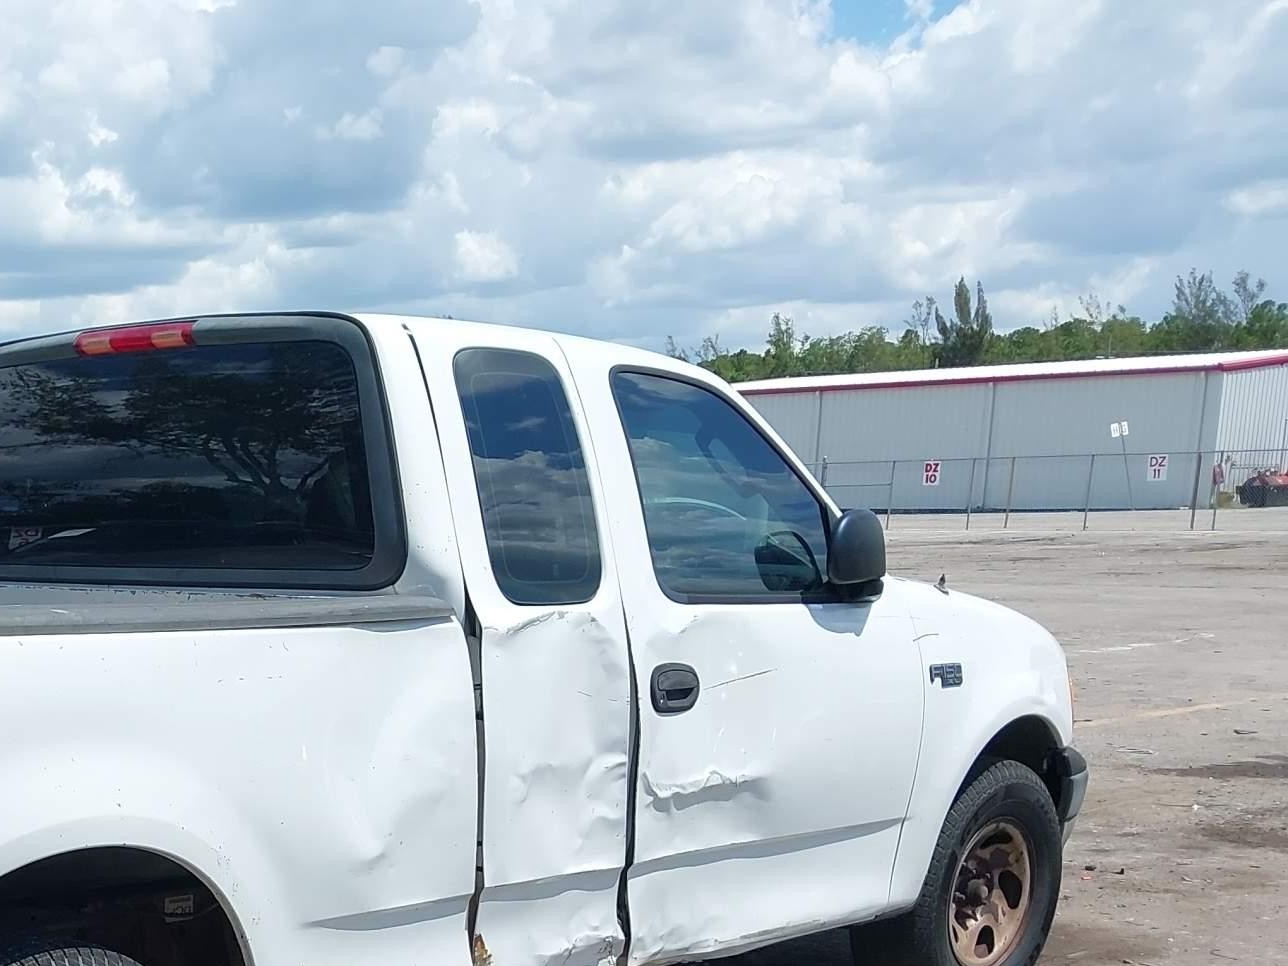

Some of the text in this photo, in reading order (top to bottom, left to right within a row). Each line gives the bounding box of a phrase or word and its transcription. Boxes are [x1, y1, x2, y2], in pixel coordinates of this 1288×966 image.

[924, 462, 940, 473] DZ
[1149, 456, 1167, 468] DZ
[925, 473, 937, 484] 10
[1153, 468, 1161, 479] 11
